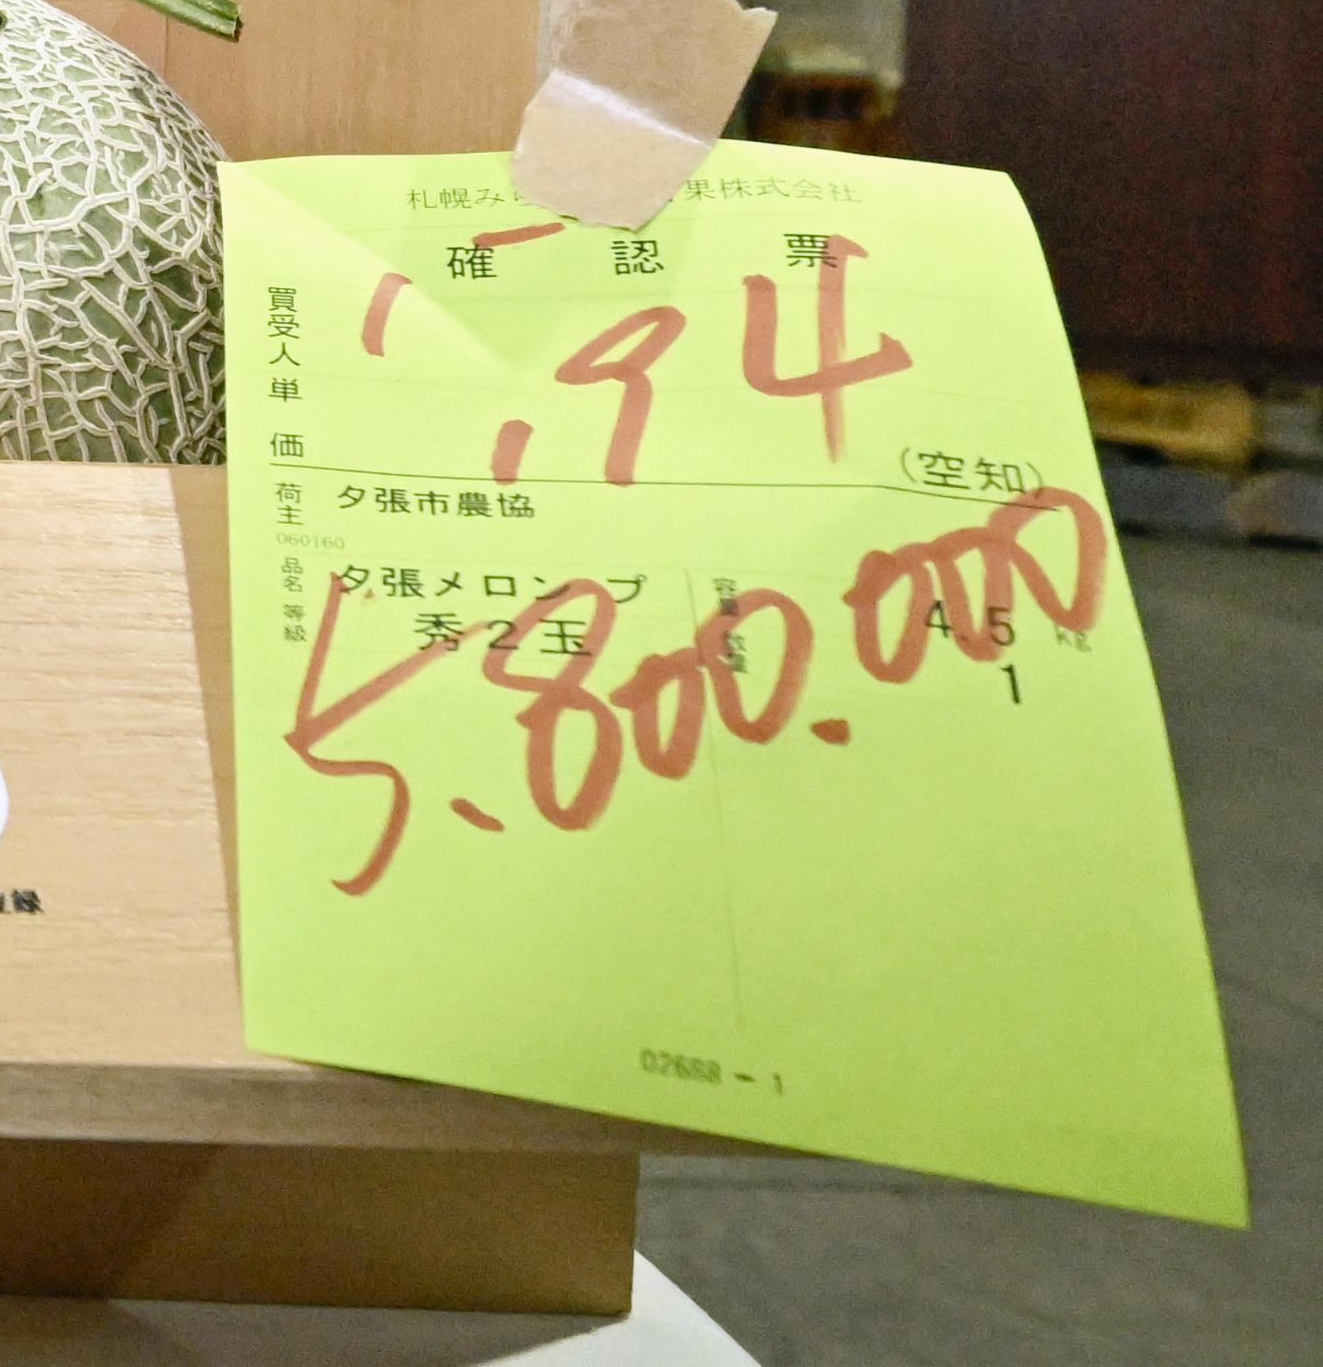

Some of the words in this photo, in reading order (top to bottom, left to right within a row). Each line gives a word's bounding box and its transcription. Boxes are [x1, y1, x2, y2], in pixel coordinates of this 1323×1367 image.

[267, 286, 301, 367] 買受人
[268, 375, 305, 459] 単価
[275, 483, 304, 526] 荷主
[337, 484, 536, 519] 夕張市農協
[282, 556, 304, 593] 品名
